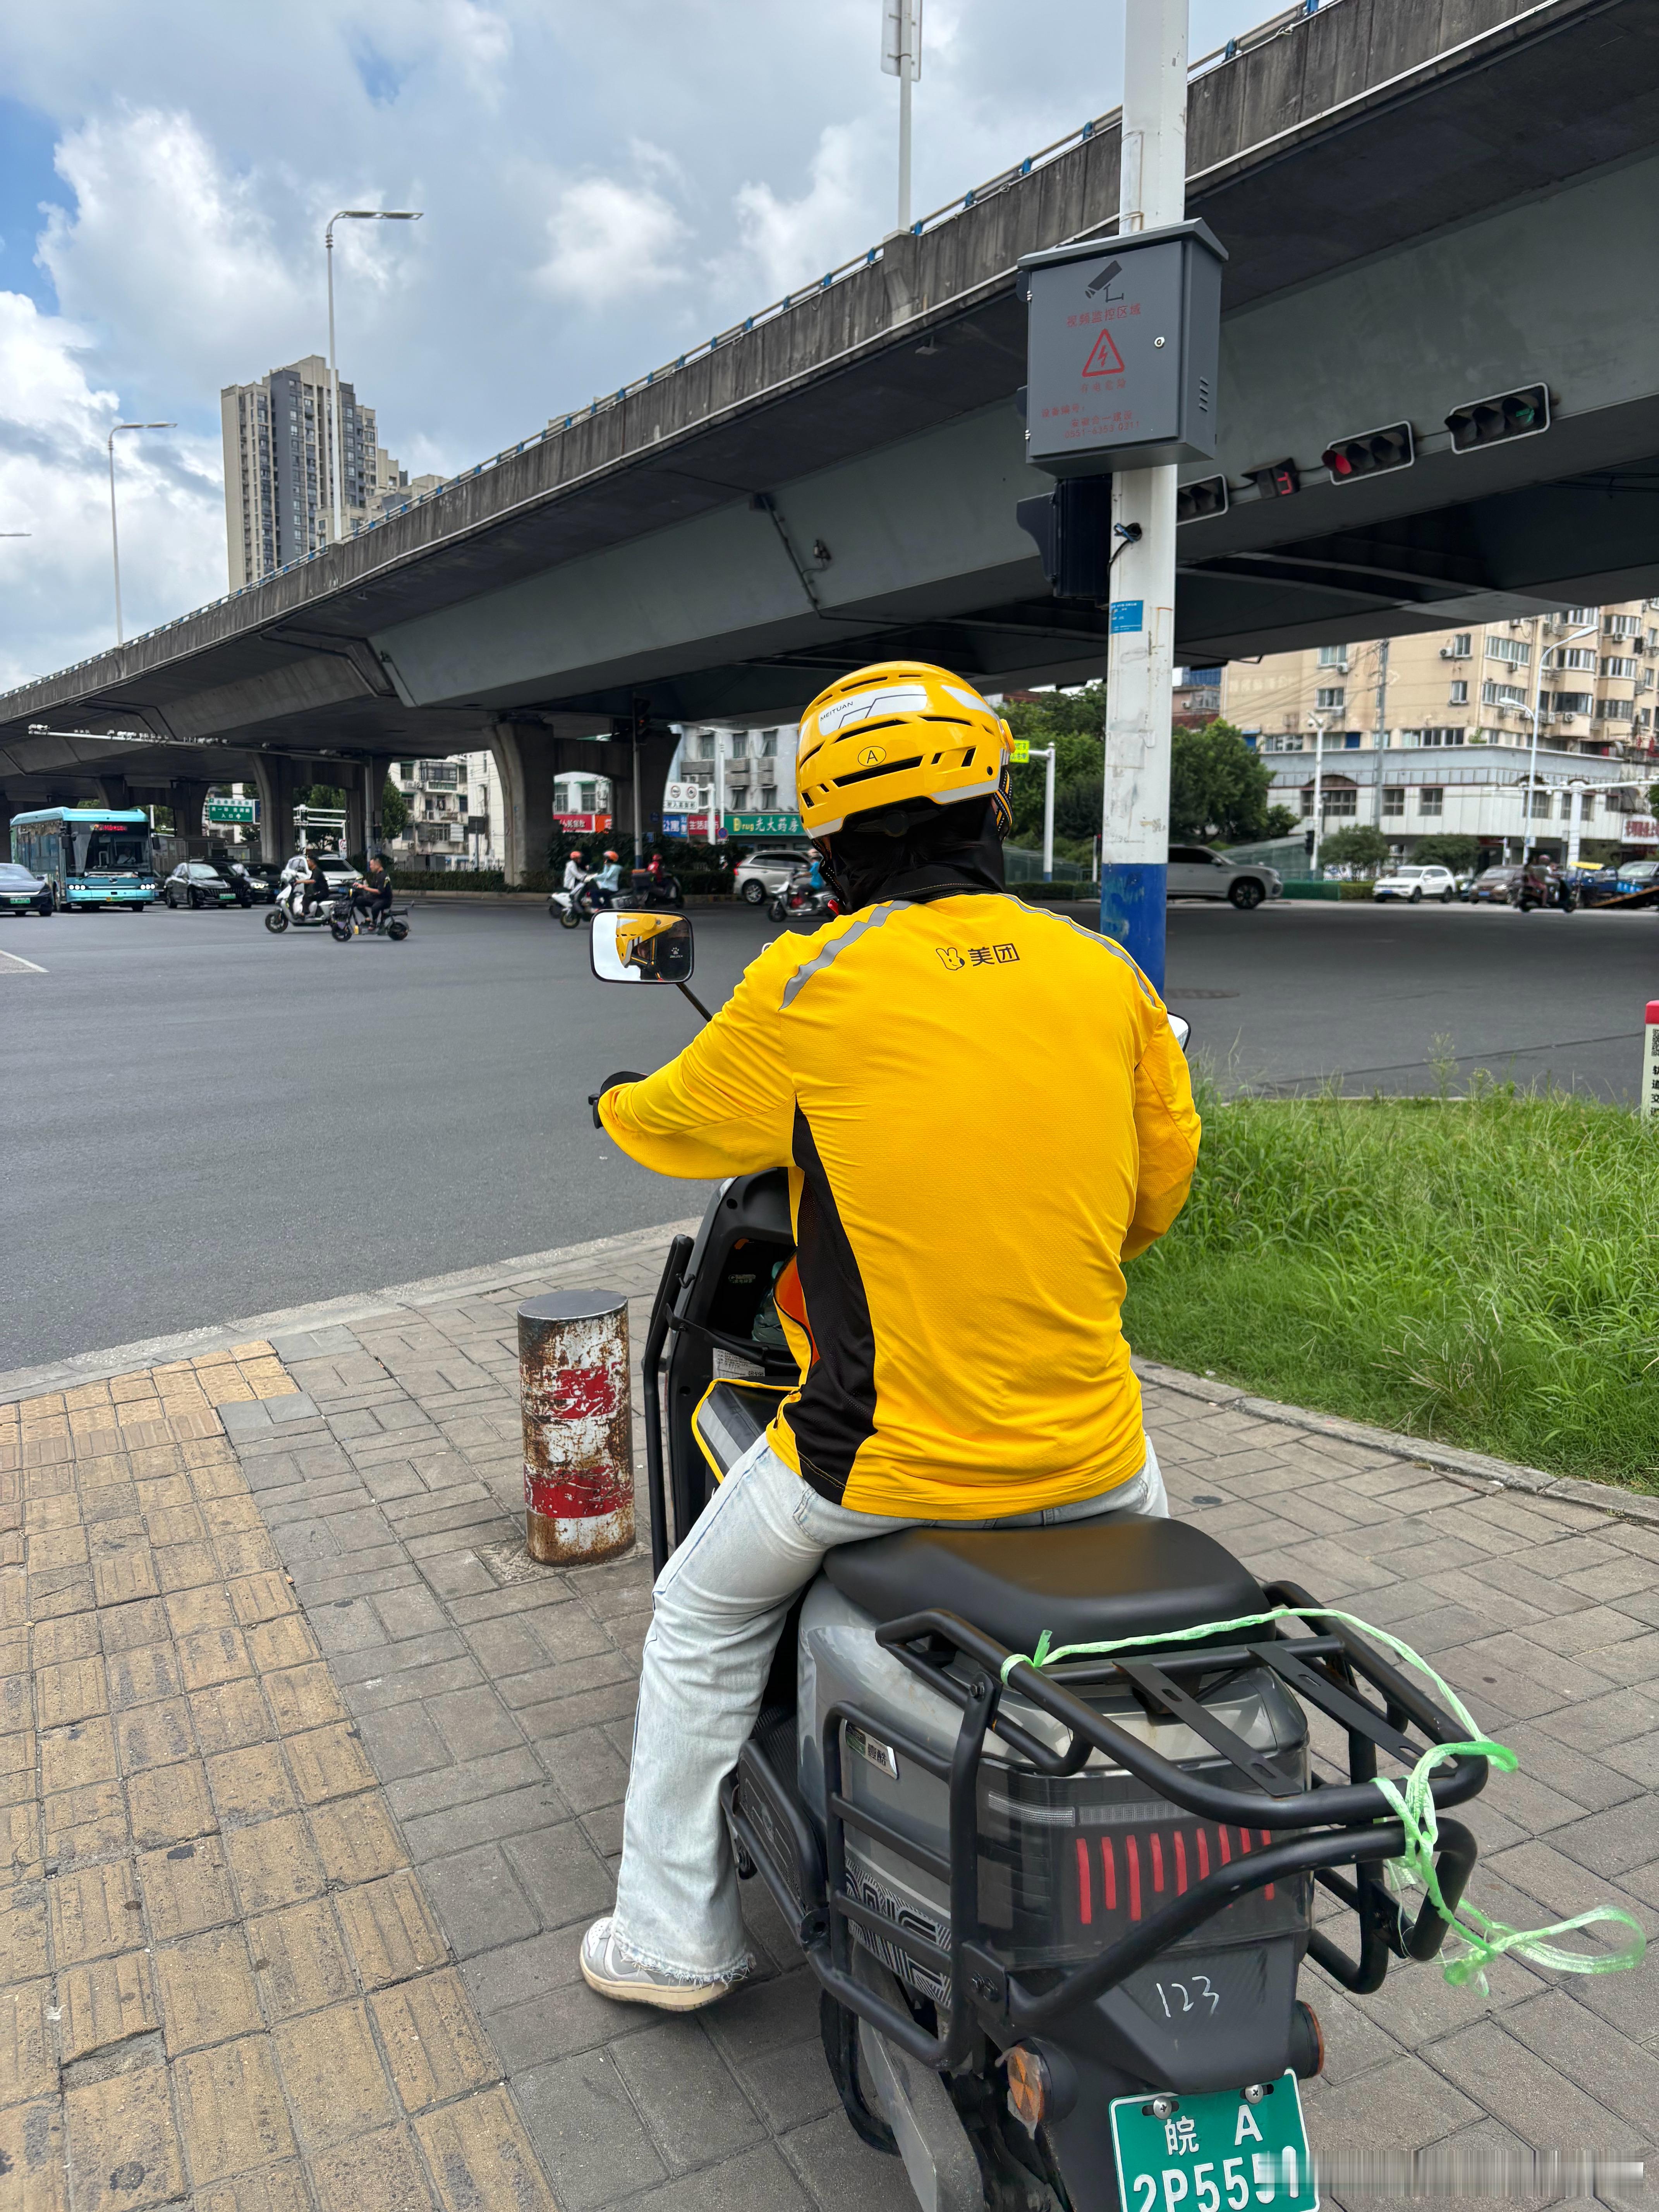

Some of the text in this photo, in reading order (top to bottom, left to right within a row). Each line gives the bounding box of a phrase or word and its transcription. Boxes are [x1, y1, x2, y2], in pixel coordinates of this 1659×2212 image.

[1067, 303, 1141, 327] 视频监控区域
[820, 701, 853, 721] MEITUAN
[867, 746, 878, 764] A
[733, 817, 799, 833] Drug 光大药房
[968, 943, 1020, 967] 美团
[1156, 1975, 1219, 2018] 123
[1165, 2104, 1263, 2156] 皖 A
